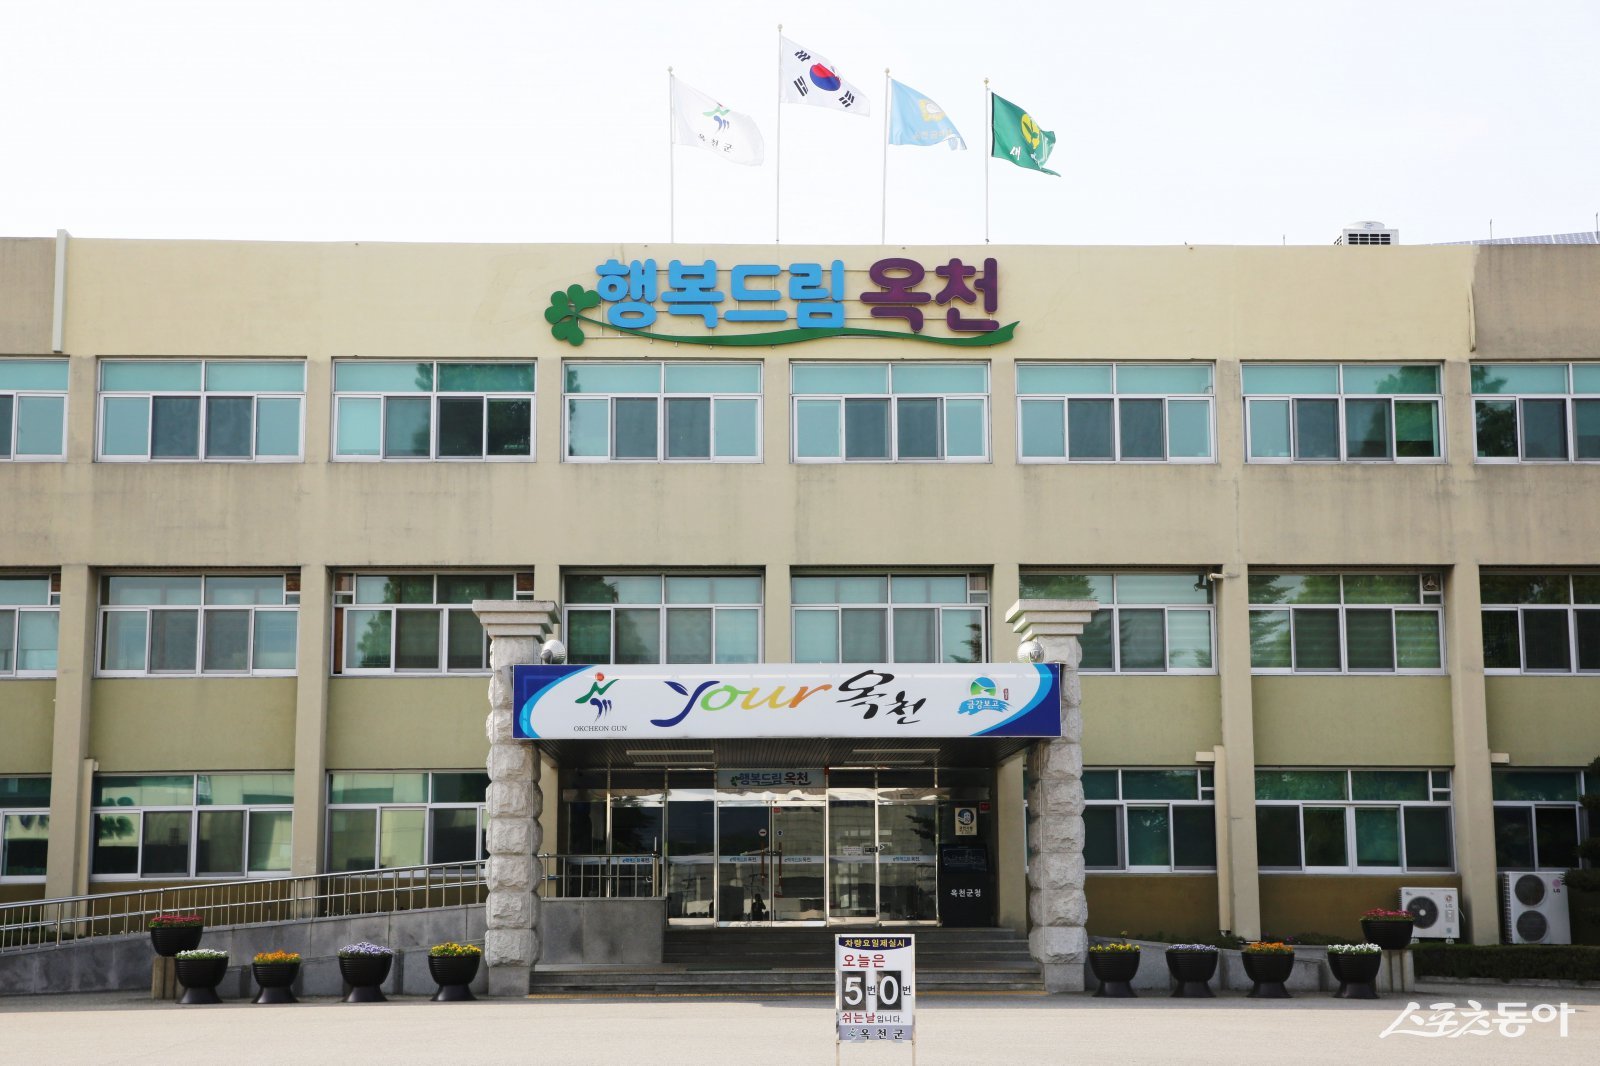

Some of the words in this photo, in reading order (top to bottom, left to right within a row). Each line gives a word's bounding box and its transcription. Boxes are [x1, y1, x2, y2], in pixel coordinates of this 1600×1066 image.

[595, 259, 845, 329] 행복드림
[859, 257, 1000, 333] 옥천
[650, 680, 833, 728] your
[835, 669, 927, 724] 옥천
[967, 699, 999, 710] 금강보고
[739, 772, 782, 785] 행복드림
[783, 771, 812, 786] 옥천
[950, 888, 982, 898] 옥천군청
[844, 938, 905, 948] 차량요일제실시
[842, 954, 885, 968] 오늘은
